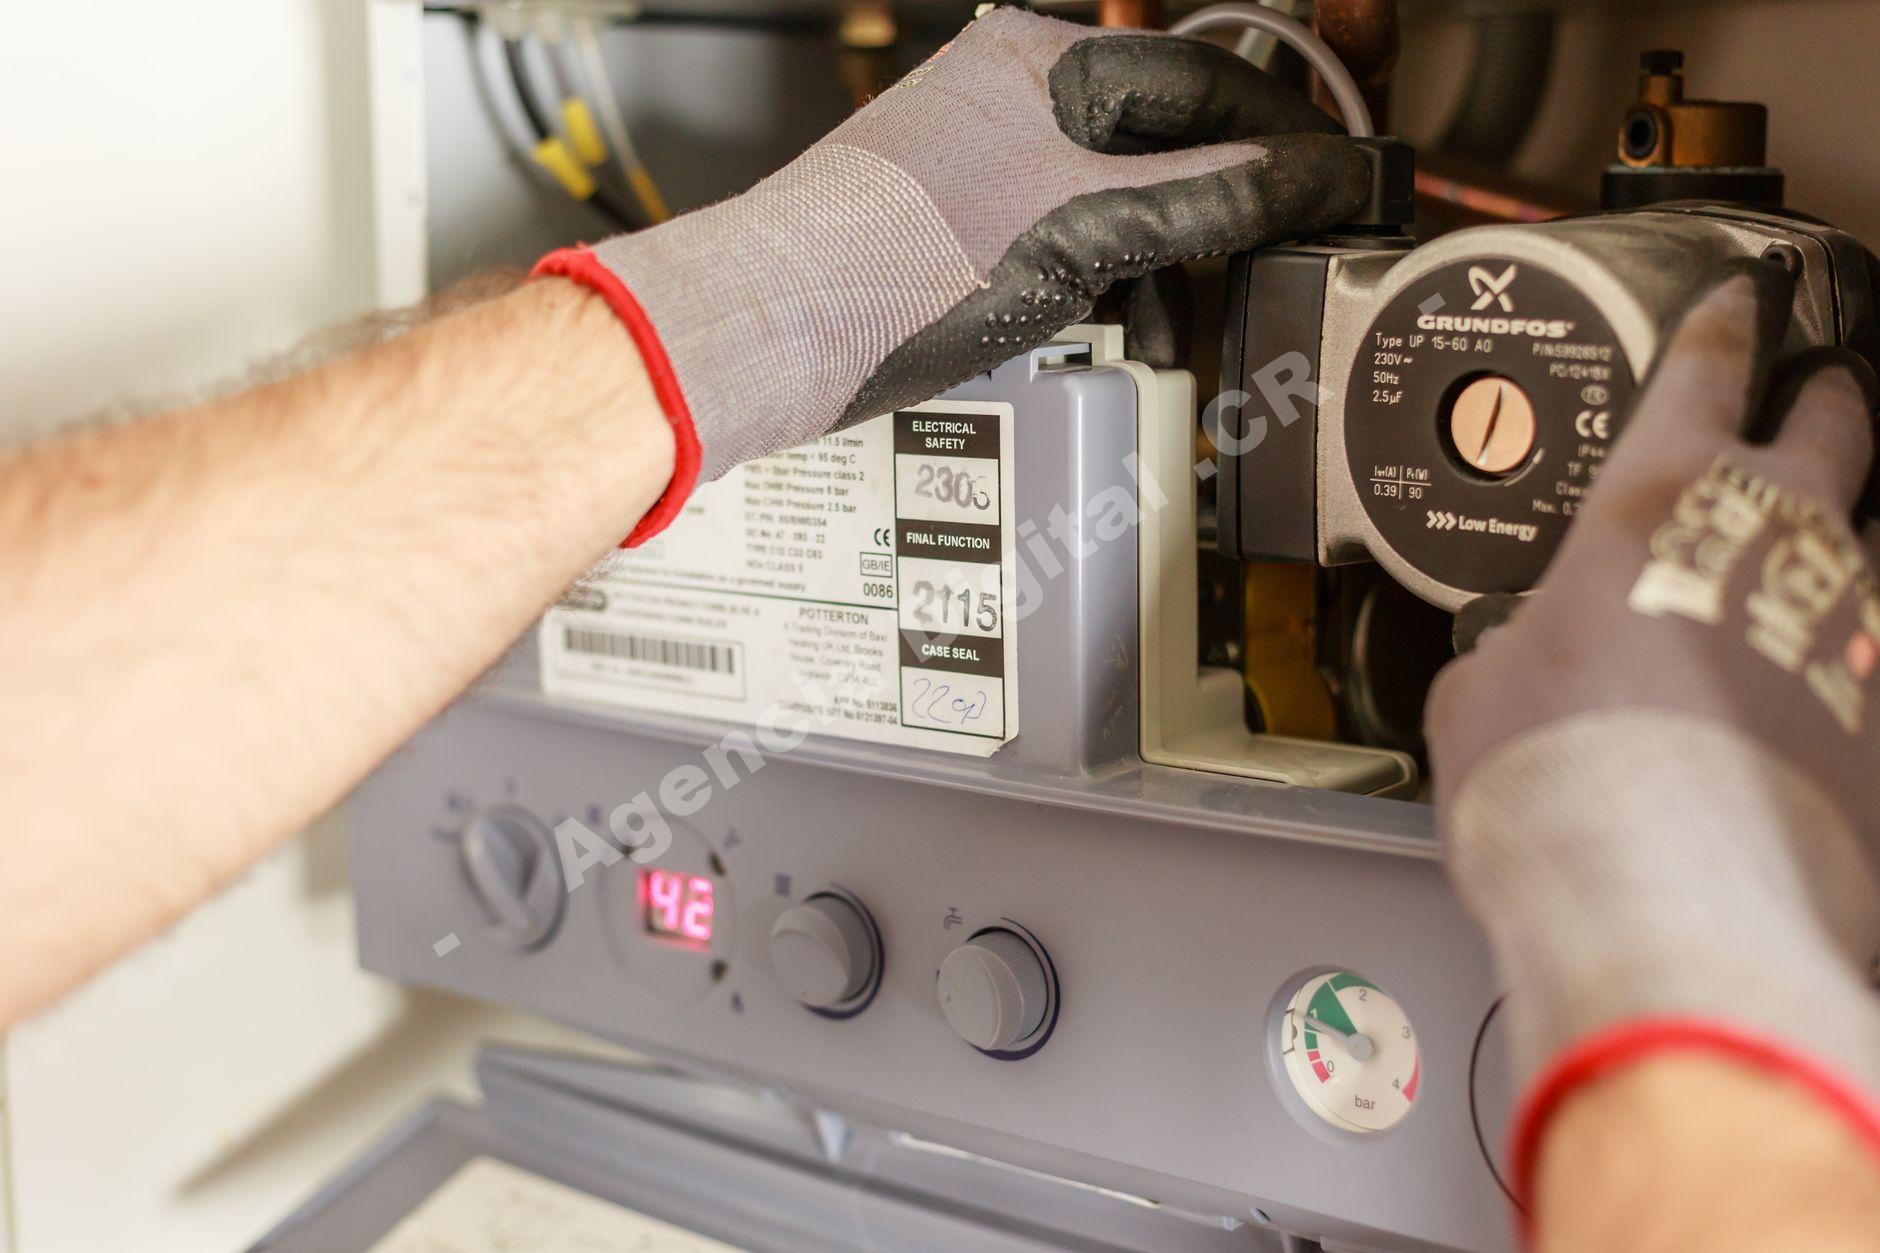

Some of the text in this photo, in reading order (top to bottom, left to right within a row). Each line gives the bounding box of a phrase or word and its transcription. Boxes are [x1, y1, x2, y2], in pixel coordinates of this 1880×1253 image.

[1417, 315, 1568, 338] GRUNDFOS
[1375, 332, 1402, 349] Type
[1409, 335, 1424, 348] UP
[1431, 336, 1467, 351] 15-60
[1373, 371, 1399, 386] 50Hz
[911, 420, 977, 435] ELECTRICAL
[924, 437, 966, 450] SAFETY
[834, 469, 857, 481] class
[858, 470, 865, 482] 2
[834, 486, 849, 496] bar
[1373, 483, 1422, 500] 0.39 90
[842, 503, 857, 513] bar
[1458, 515, 1539, 543] Low Energy
[906, 531, 990, 550] FINAL FUNCTION
[862, 559, 891, 573] GB/IE
[863, 582, 894, 598] 0086
[799, 607, 869, 625] POTTERTON
[859, 630, 867, 640] of
[869, 631, 888, 642] Baxi
[854, 644, 884, 657] Brooks
[921, 643, 980, 662] CASE SEAL
[649, 870, 714, 941] 42
[1358, 988, 1368, 1002] 2
[1402, 1025, 1411, 1039] 3
[1326, 1060, 1335, 1073] 0
[1392, 1078, 1401, 1090] 4
[1354, 1094, 1377, 1111] bar
